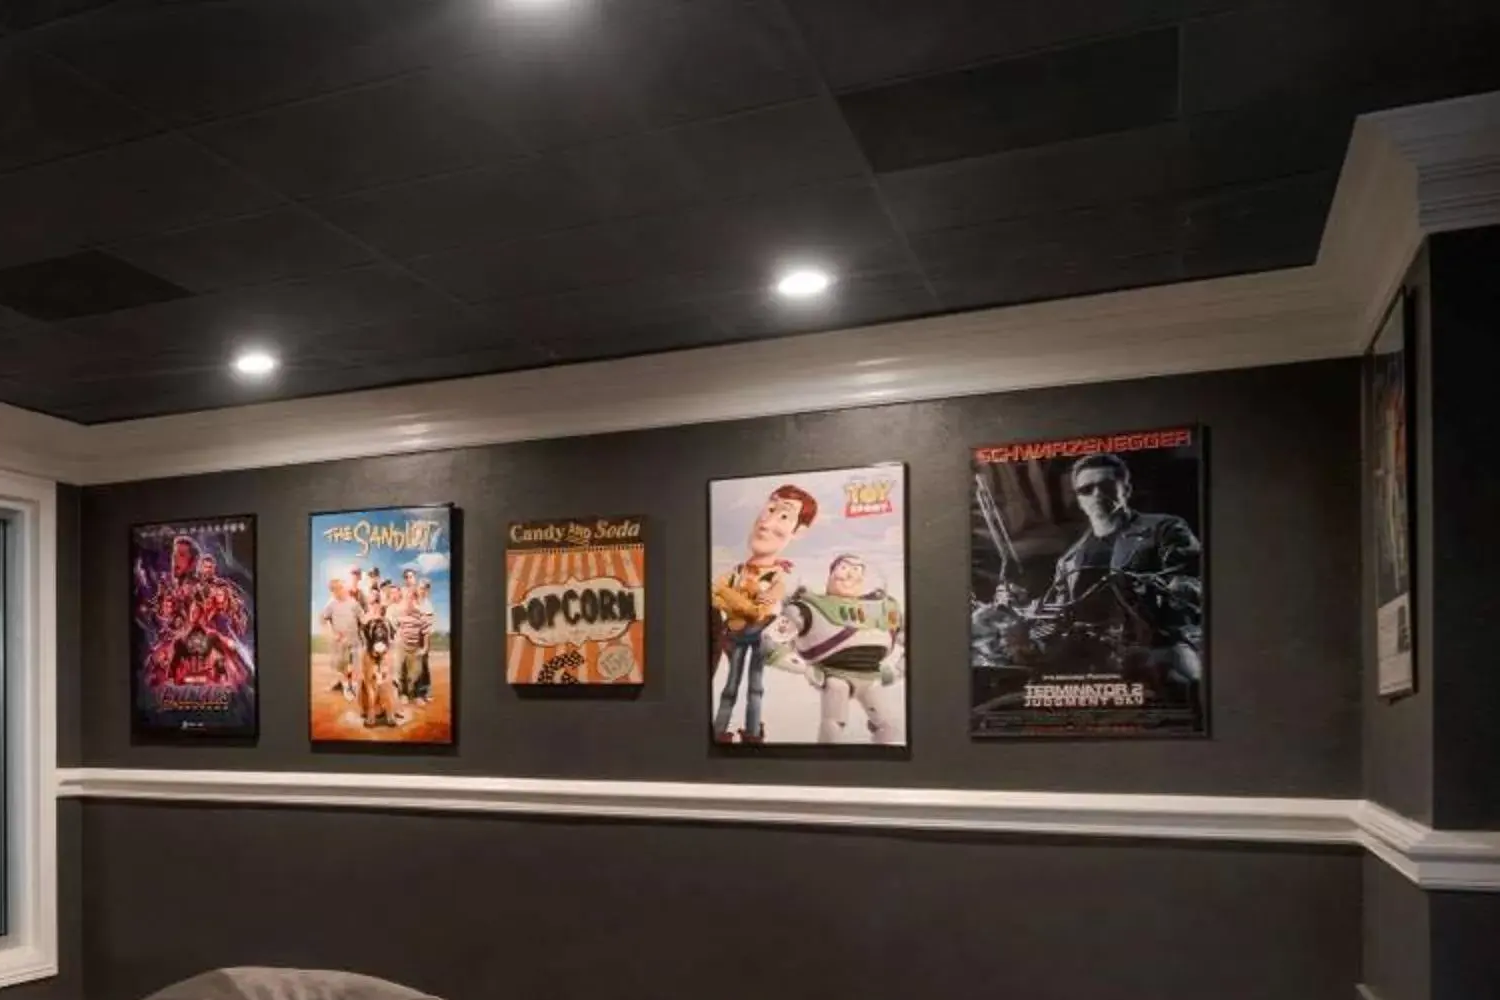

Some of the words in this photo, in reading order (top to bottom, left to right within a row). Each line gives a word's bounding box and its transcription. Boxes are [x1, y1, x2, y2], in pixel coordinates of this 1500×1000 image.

[975, 429, 1192, 464] SCHWARZENEGGER
[844, 479, 896, 504] TOY
[324, 526, 354, 543] THE
[509, 523, 565, 543] Candy
[593, 519, 641, 539] Soda
[511, 588, 636, 632] POPCORN
